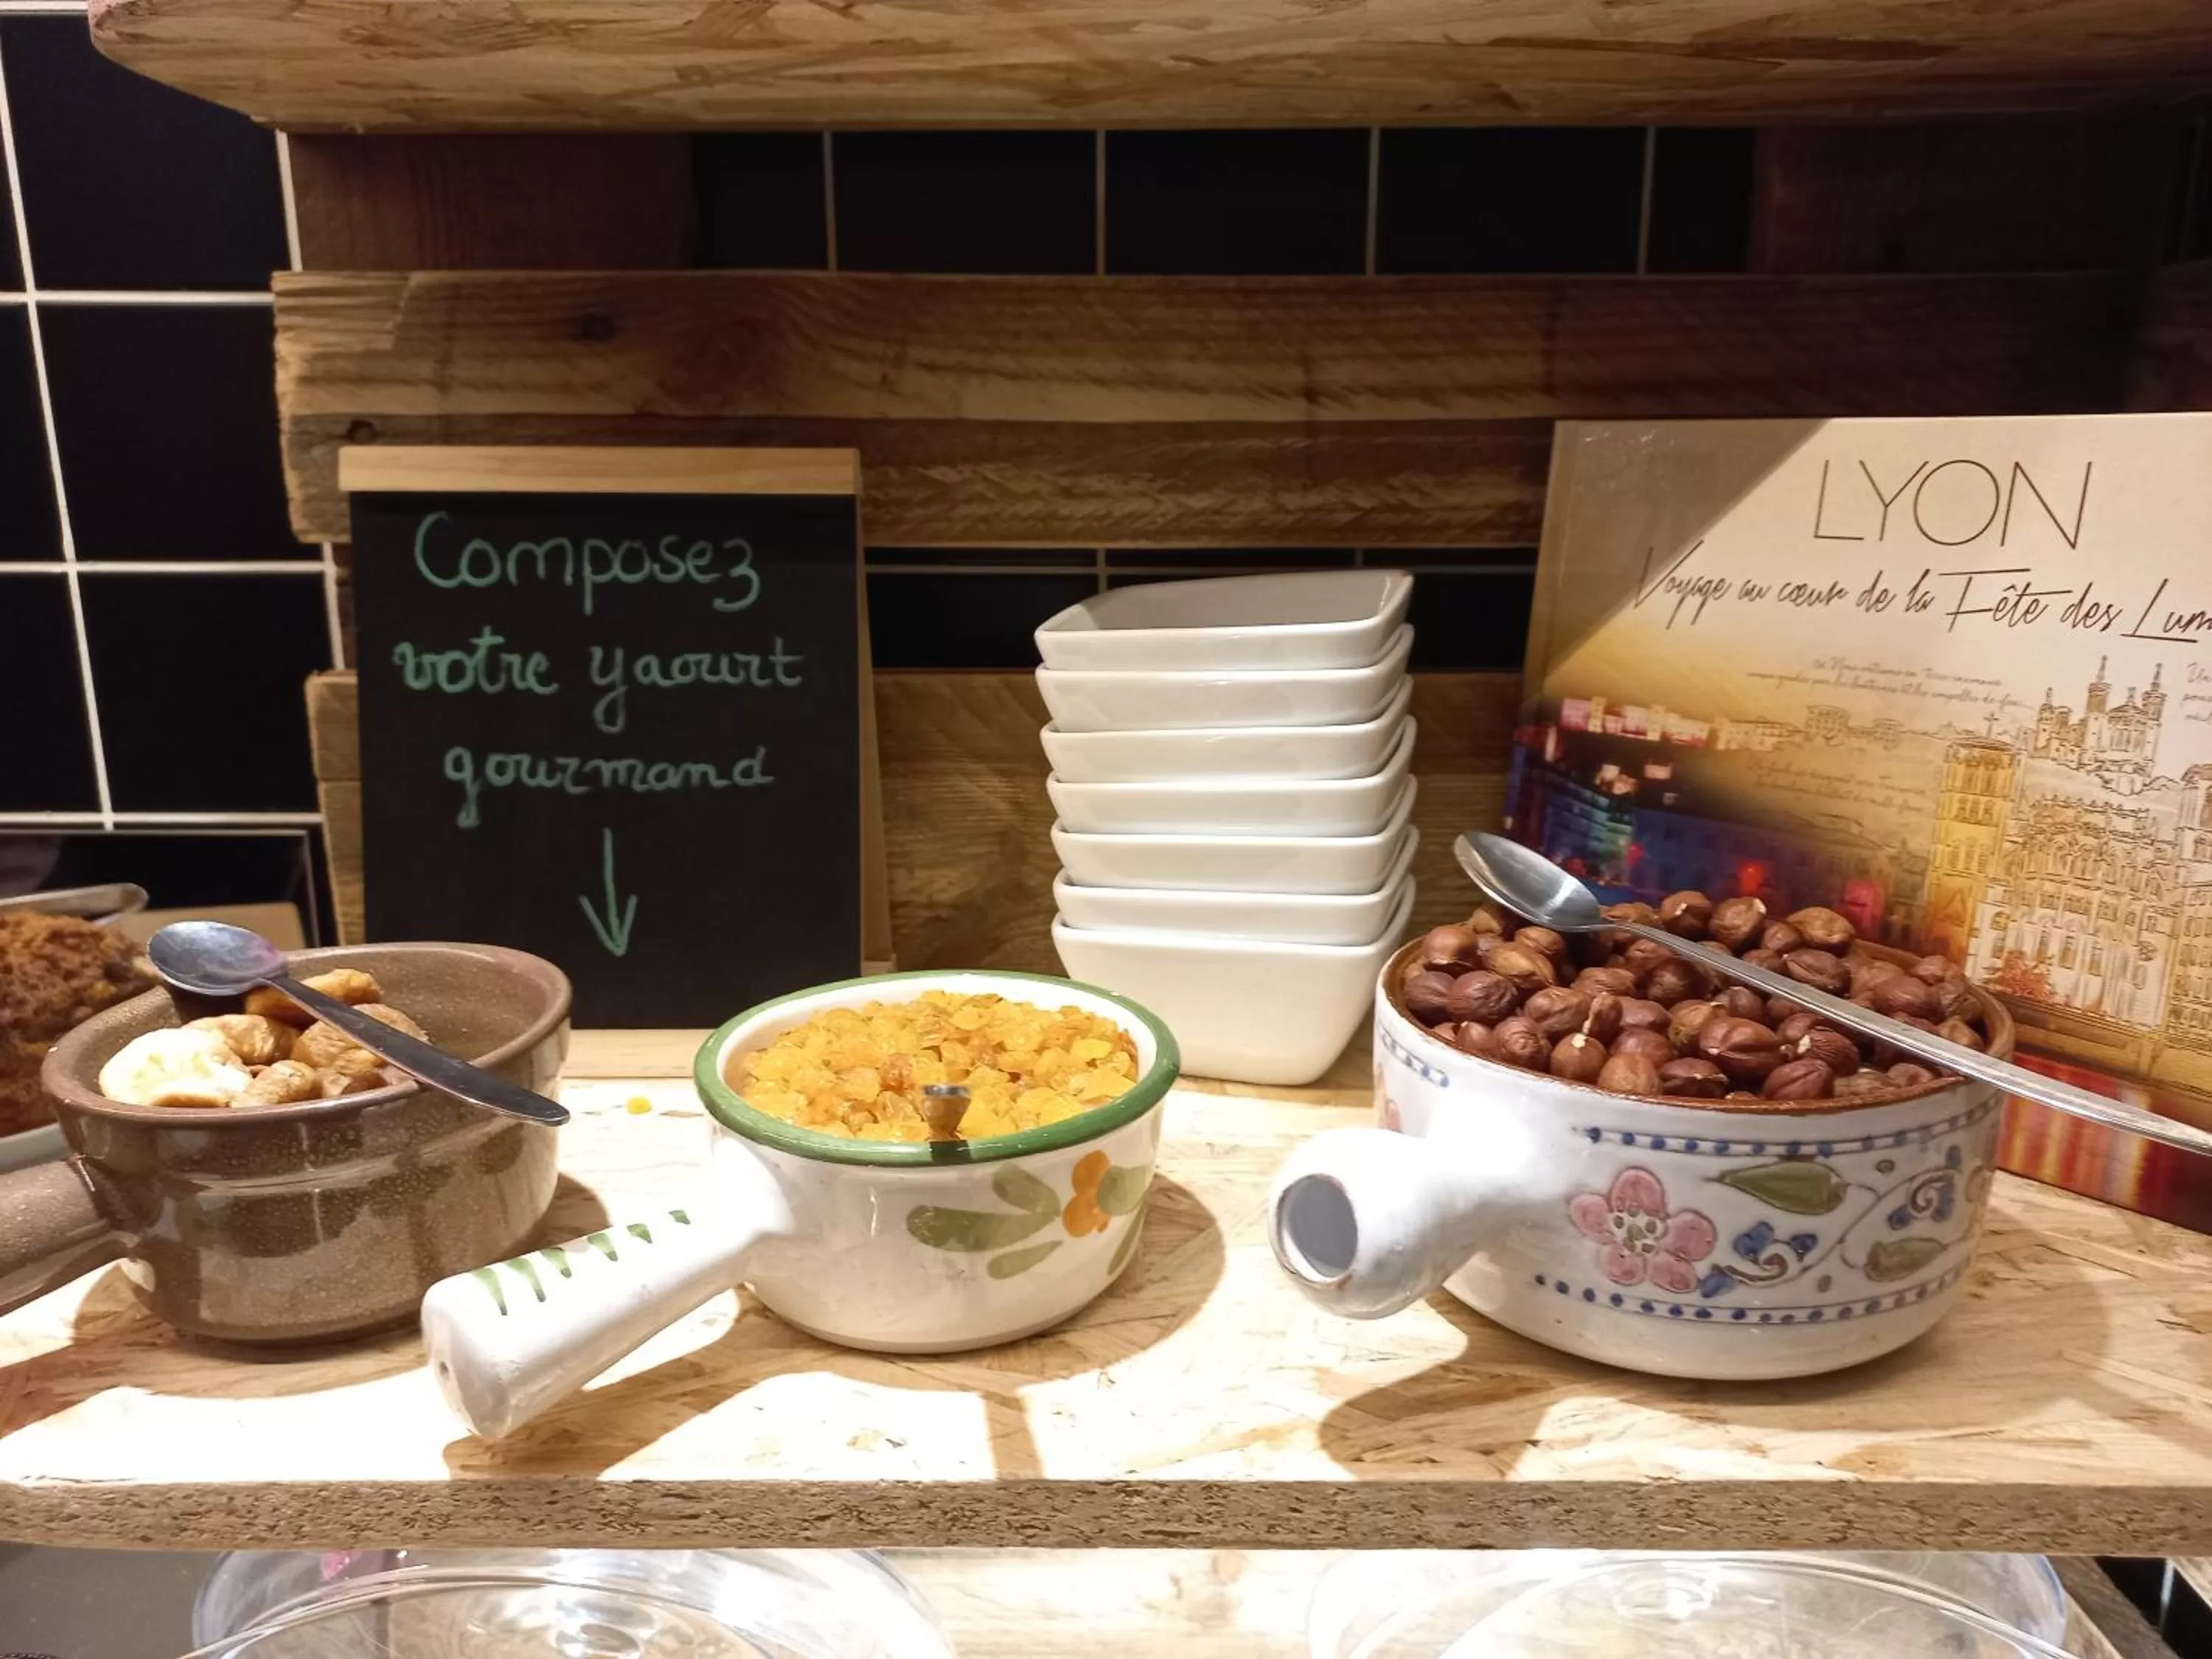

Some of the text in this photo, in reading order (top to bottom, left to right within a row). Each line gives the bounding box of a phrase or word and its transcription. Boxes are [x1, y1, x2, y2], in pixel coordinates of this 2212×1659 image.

[1814, 459, 2092, 549] LYON
[414, 511, 760, 615] Composez
[1634, 540, 1731, 630] Voyage
[1738, 579, 1771, 602] au
[1777, 581, 1848, 607] cœur
[1855, 569, 1896, 613] de
[1905, 568, 1937, 616] la
[1938, 568, 2073, 633] Fête
[2061, 581, 2123, 632] des
[392, 625, 804, 733] votre yaourt
[444, 745, 775, 827] gourmand
